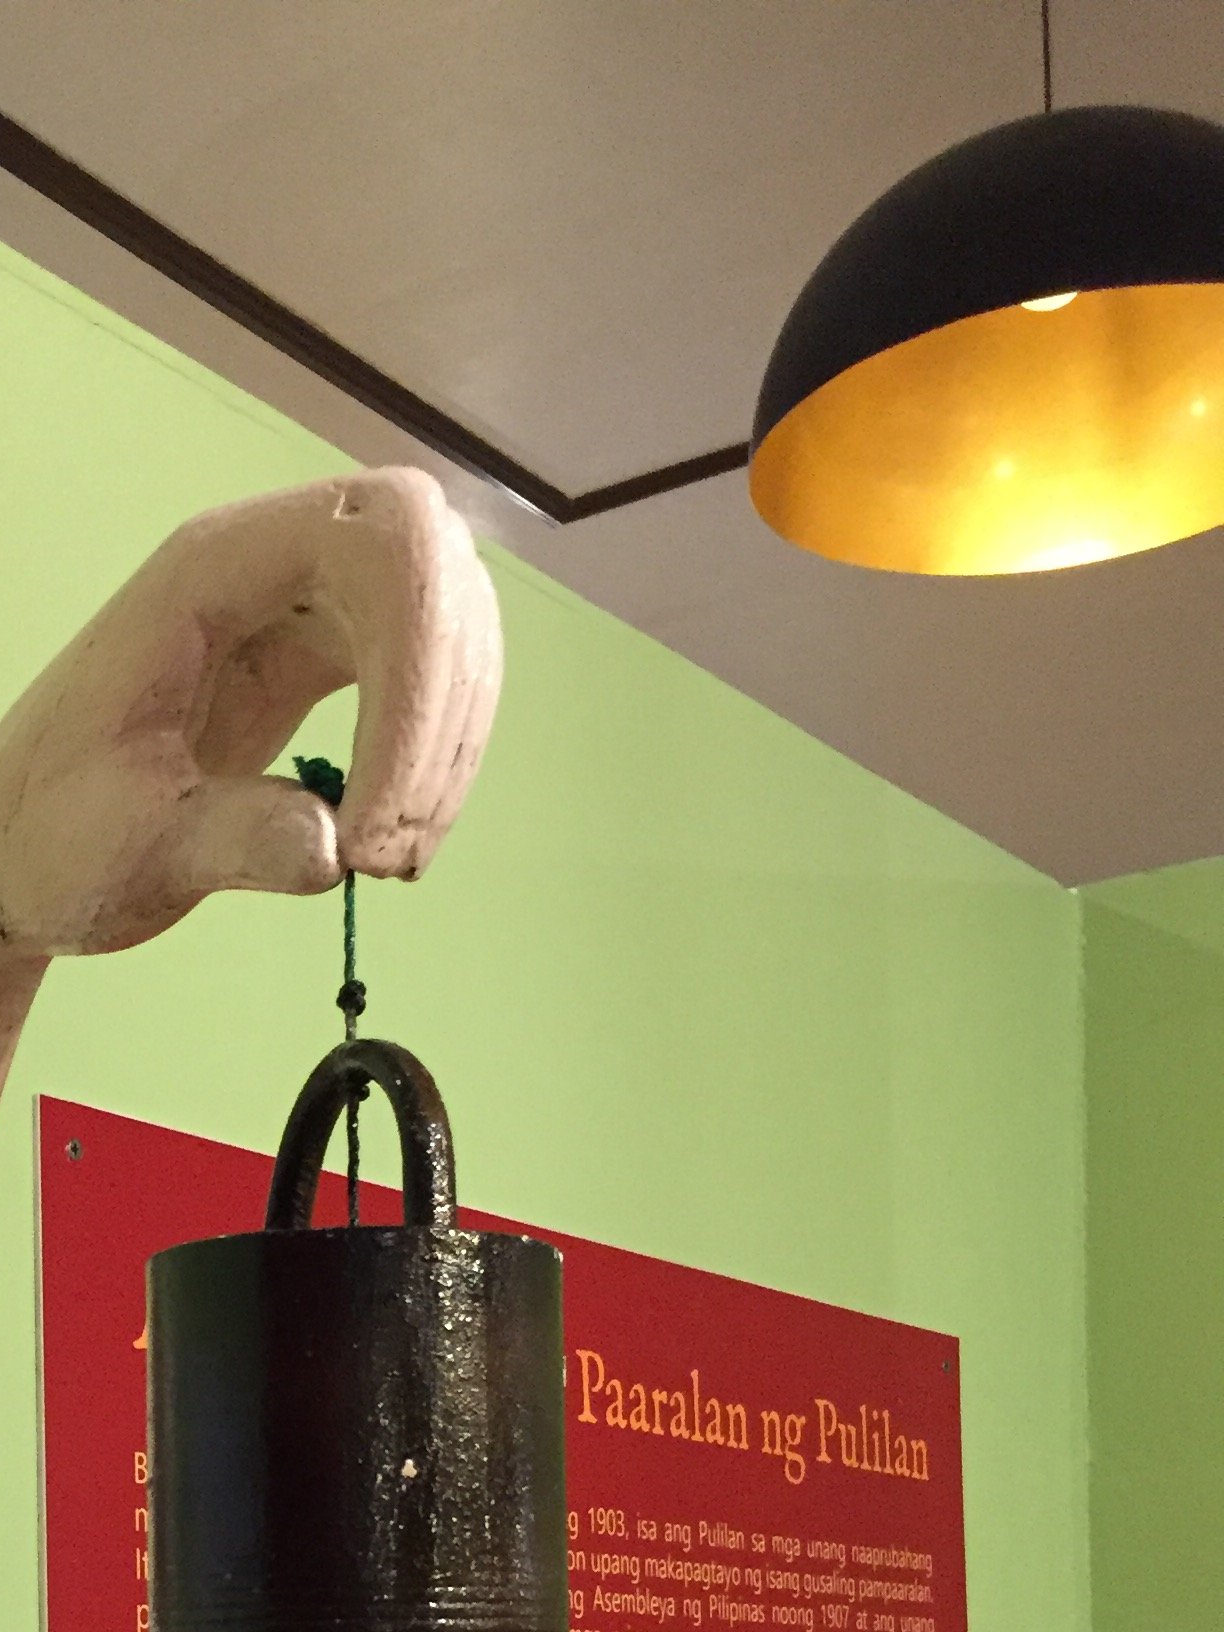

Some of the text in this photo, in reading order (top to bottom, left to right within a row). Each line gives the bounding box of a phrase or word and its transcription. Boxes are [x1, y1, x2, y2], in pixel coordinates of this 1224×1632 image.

[575, 1349, 930, 1485] Paaralan ng Pulilan
[587, 1507, 629, 1541] 1903,
[637, 1519, 657, 1541] isa
[664, 1522, 692, 1553] ang
[698, 1520, 745, 1550] Pulilan
[750, 1533, 766, 1554] sa
[771, 1535, 801, 1563] mga
[806, 1540, 847, 1569] unang
[590, 1552, 641, 1585] upang
[644, 1553, 741, 1592] makapagtayo
[803, 1570, 856, 1603] gusaling
[593, 1585, 676, 1625] Asembleya
[709, 1594, 766, 1628] Pilipinas
[820, 1603, 850, 1629] 1907
